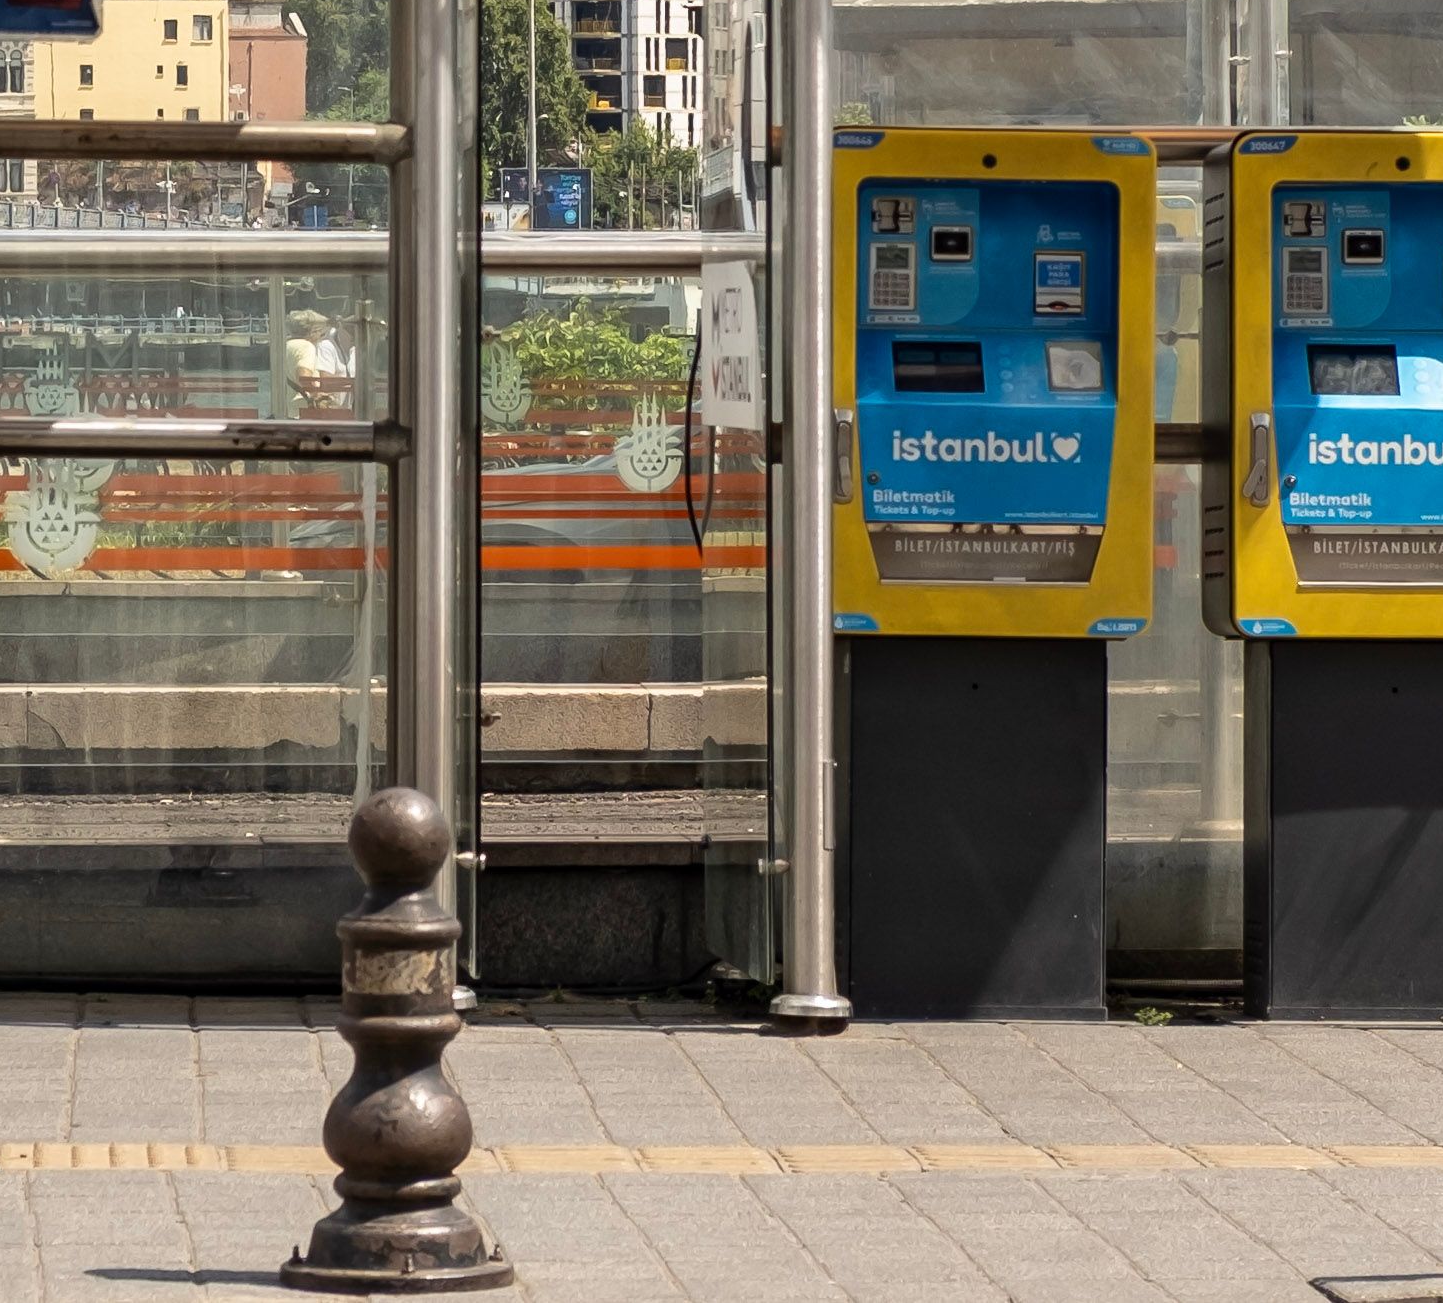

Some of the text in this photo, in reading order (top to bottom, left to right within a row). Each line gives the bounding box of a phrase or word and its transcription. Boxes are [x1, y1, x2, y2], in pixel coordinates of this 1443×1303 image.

[892, 430, 1046, 463] istanbul
[873, 489, 955, 503] Biletmatik
[1290, 492, 1372, 507] Biletmatik
[874, 505, 955, 517] Tickets & Top-up
[1291, 508, 1372, 520] Tickets & Top-up
